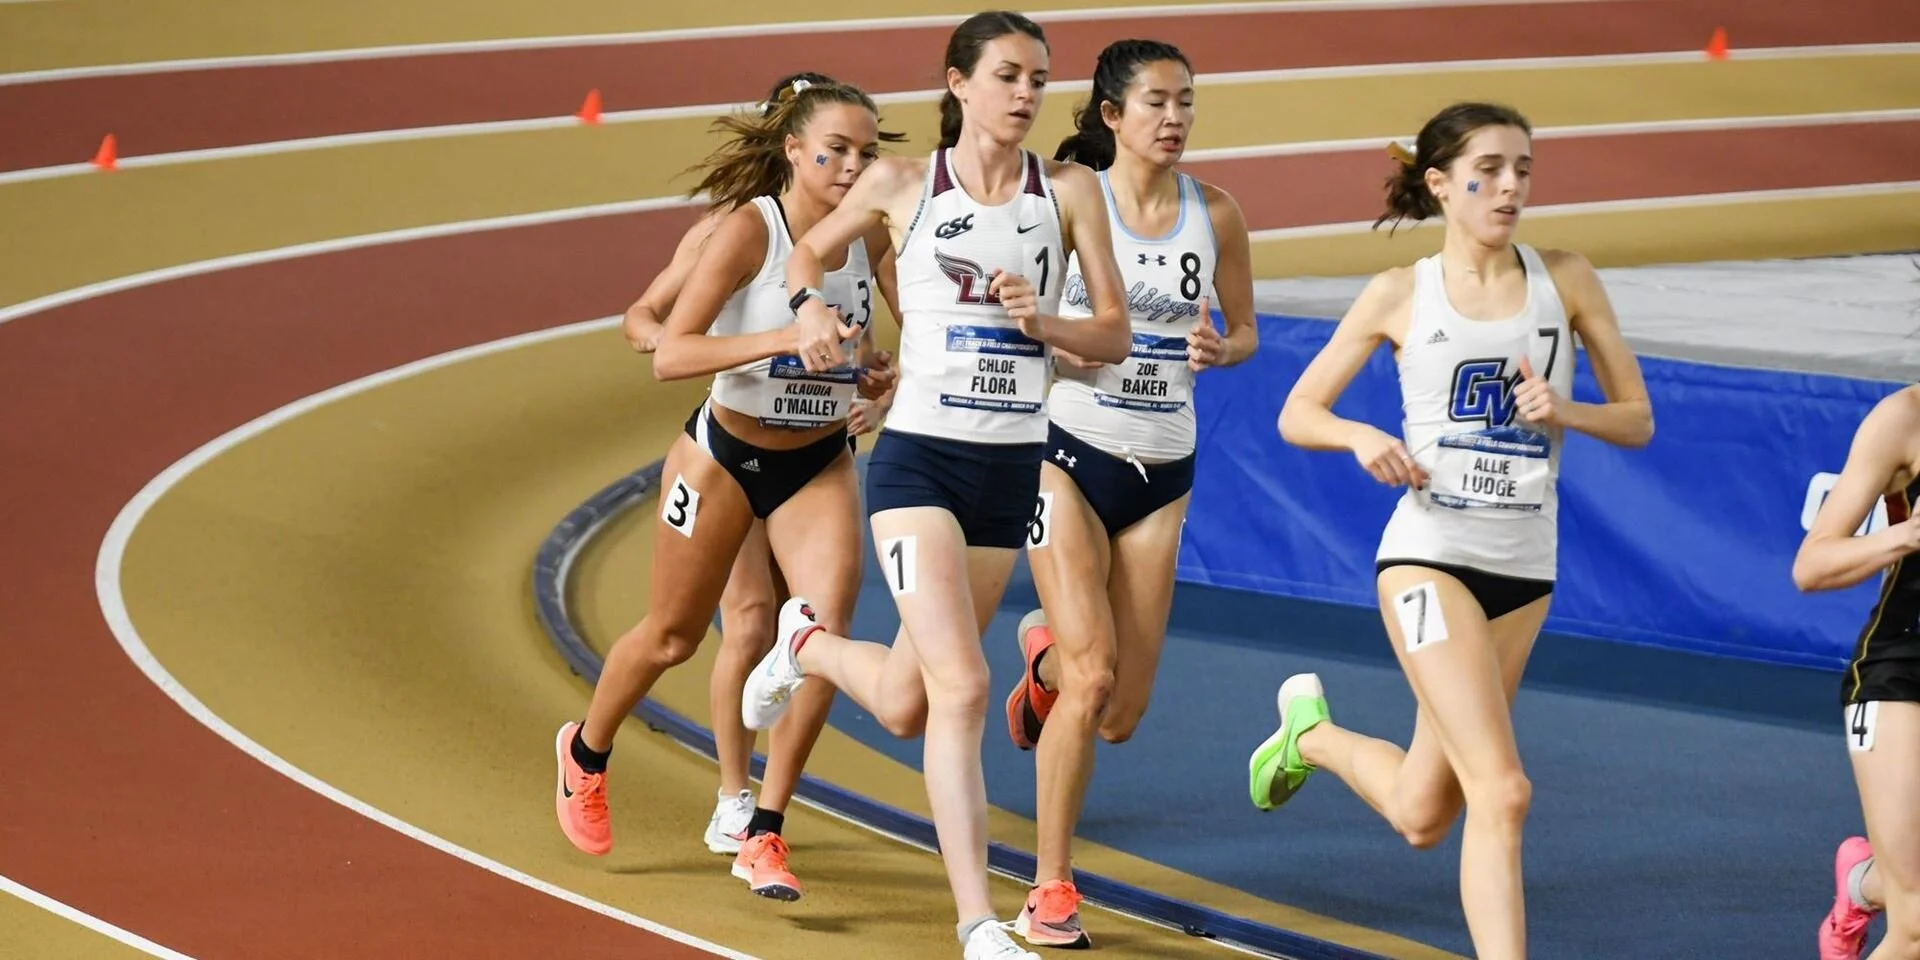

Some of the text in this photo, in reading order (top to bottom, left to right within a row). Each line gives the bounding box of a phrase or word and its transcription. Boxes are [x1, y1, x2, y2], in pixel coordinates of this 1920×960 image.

[935, 212, 975, 239] GSC
[1034, 246, 1049, 297] 1
[1180, 252, 1202, 301] 8
[857, 280, 871, 330] 3
[978, 358, 1016, 374] CHLOE
[1136, 362, 1160, 377] ZOE
[1538, 327, 1560, 382] 7
[784, 382, 832, 397] KLAUDIA
[970, 375, 1017, 395] FLORA
[1121, 377, 1168, 397] BAKER
[774, 397, 838, 417] O'MALLEY
[1473, 456, 1511, 475] ALLIE
[1461, 473, 1517, 498] LUDGE
[667, 482, 689, 528] 3
[1029, 495, 1046, 546] 8
[889, 539, 905, 591] 1
[1403, 587, 1427, 645] 7
[1852, 701, 1869, 747] 4
